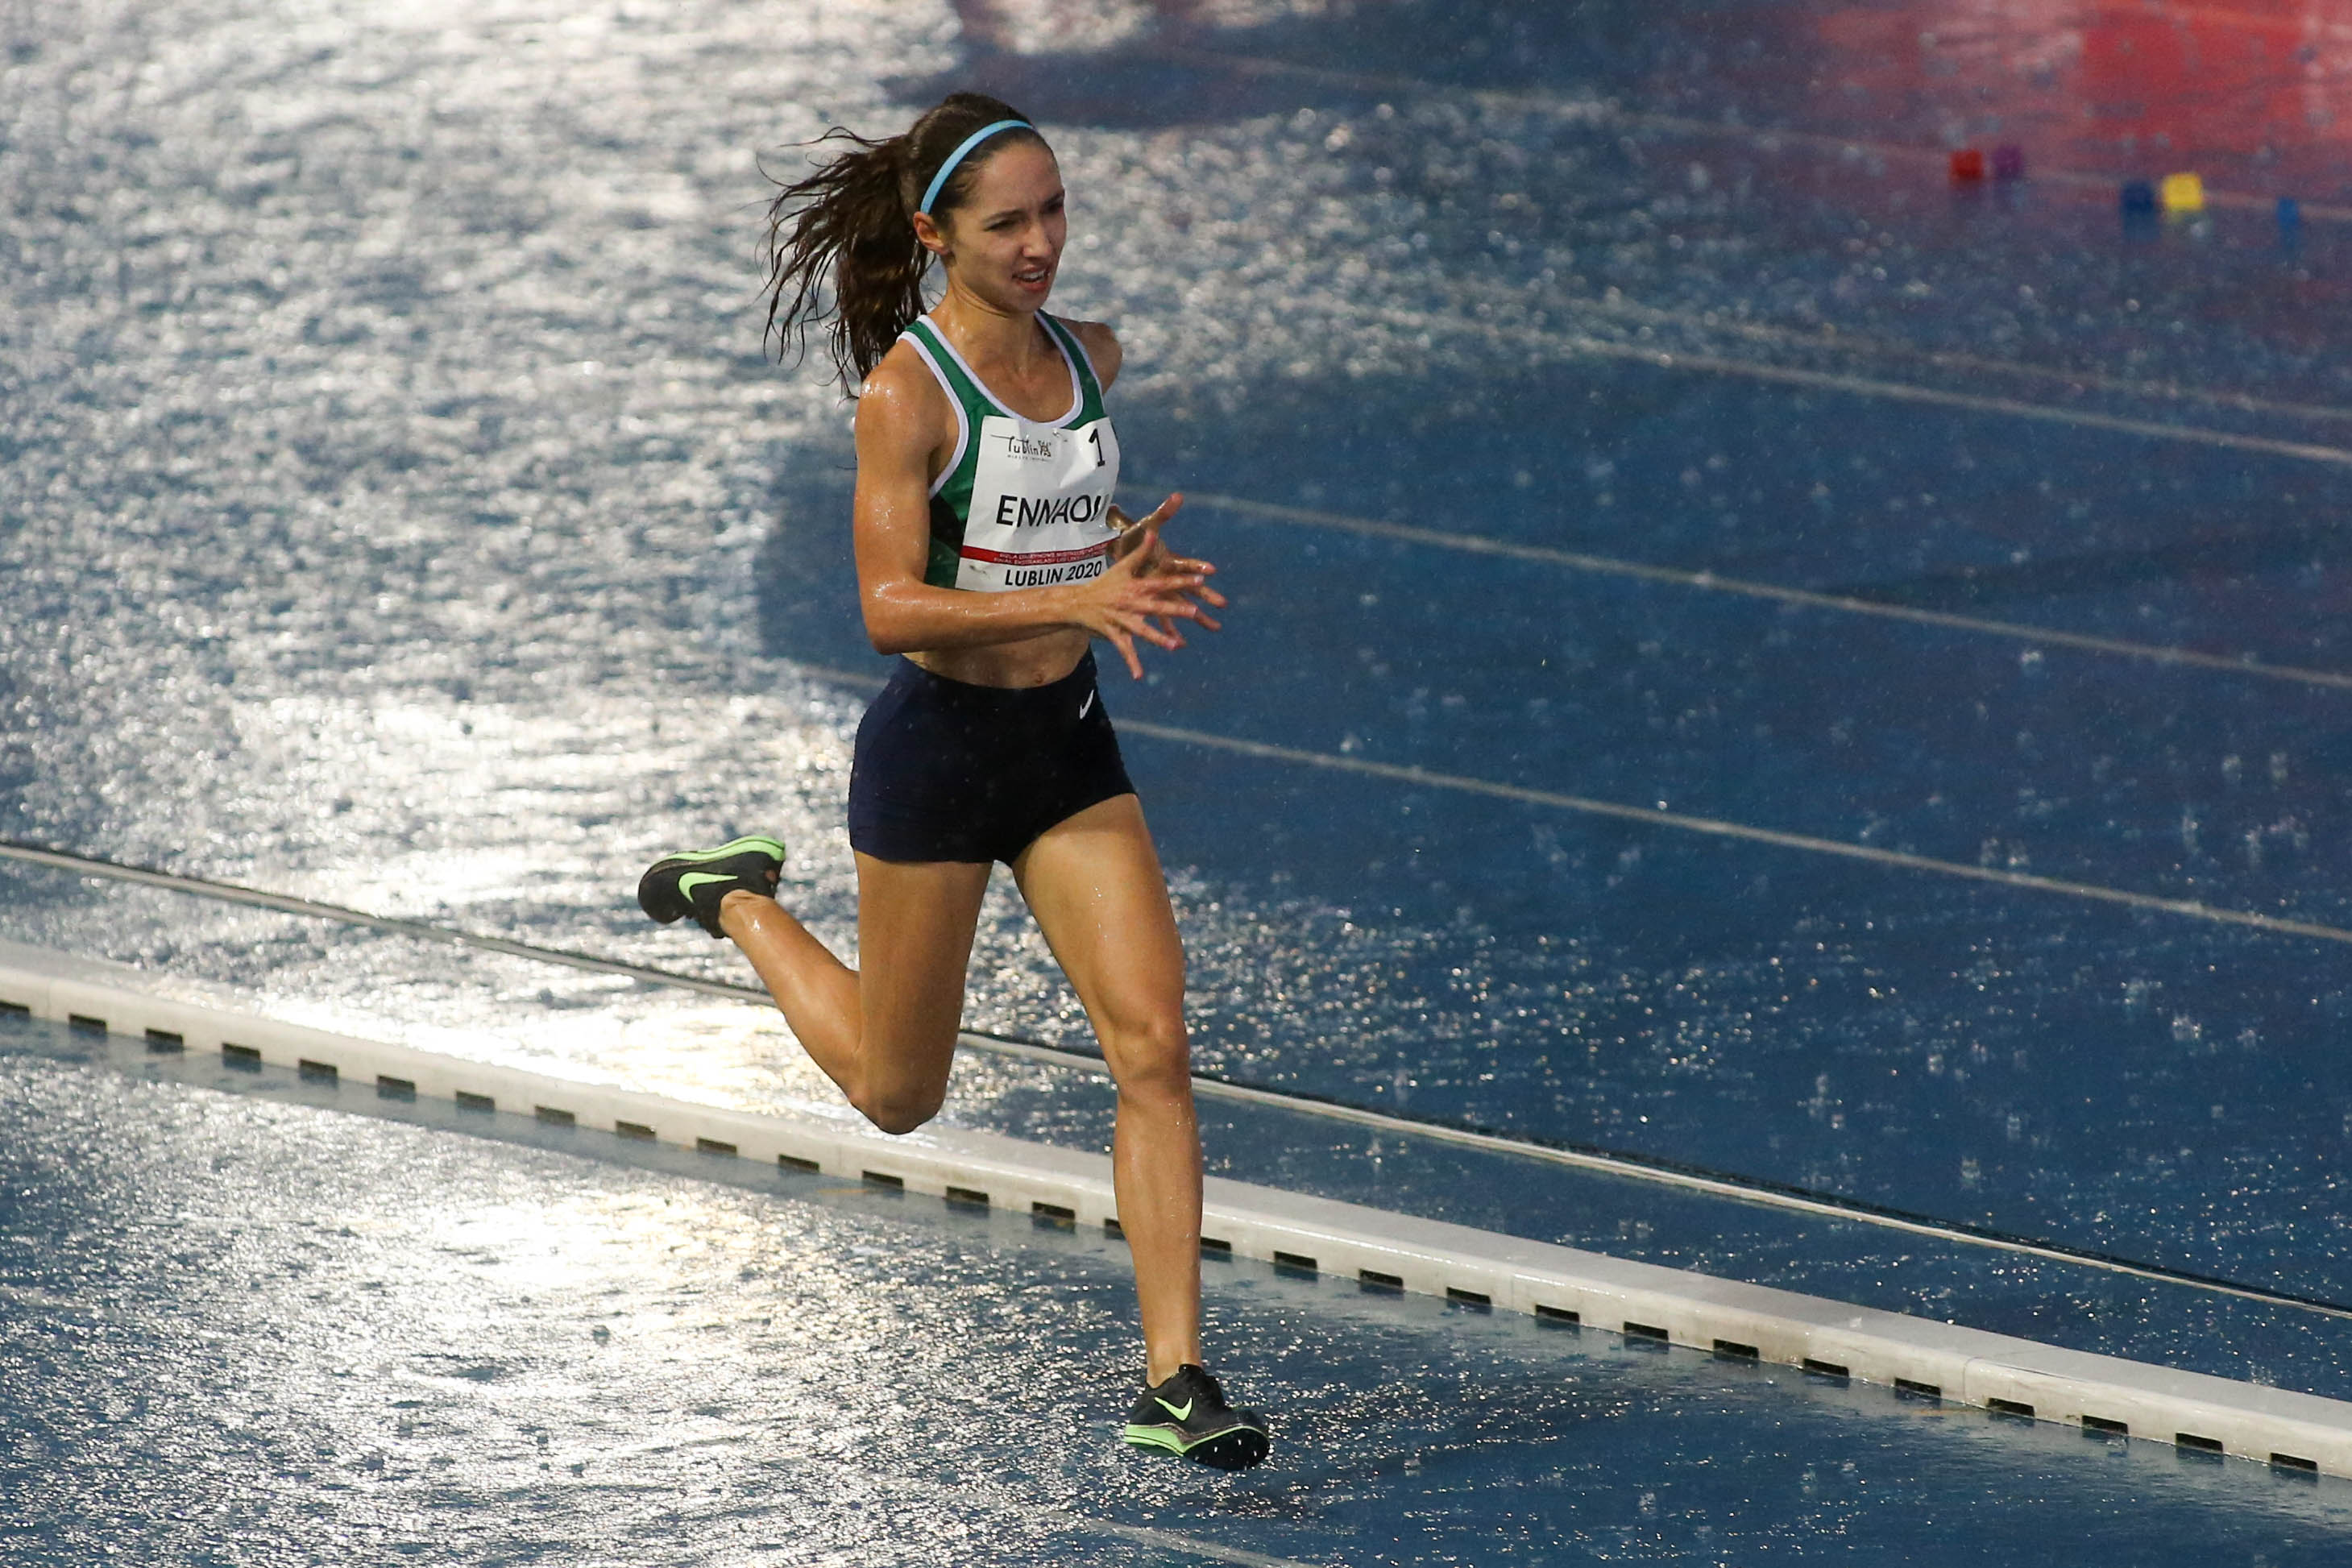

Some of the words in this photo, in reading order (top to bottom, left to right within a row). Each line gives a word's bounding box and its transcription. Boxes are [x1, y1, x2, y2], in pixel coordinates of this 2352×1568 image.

[1089, 428, 1106, 467] 1
[1005, 568, 1064, 587] LUBLIN
[1065, 560, 1102, 581] 2020
